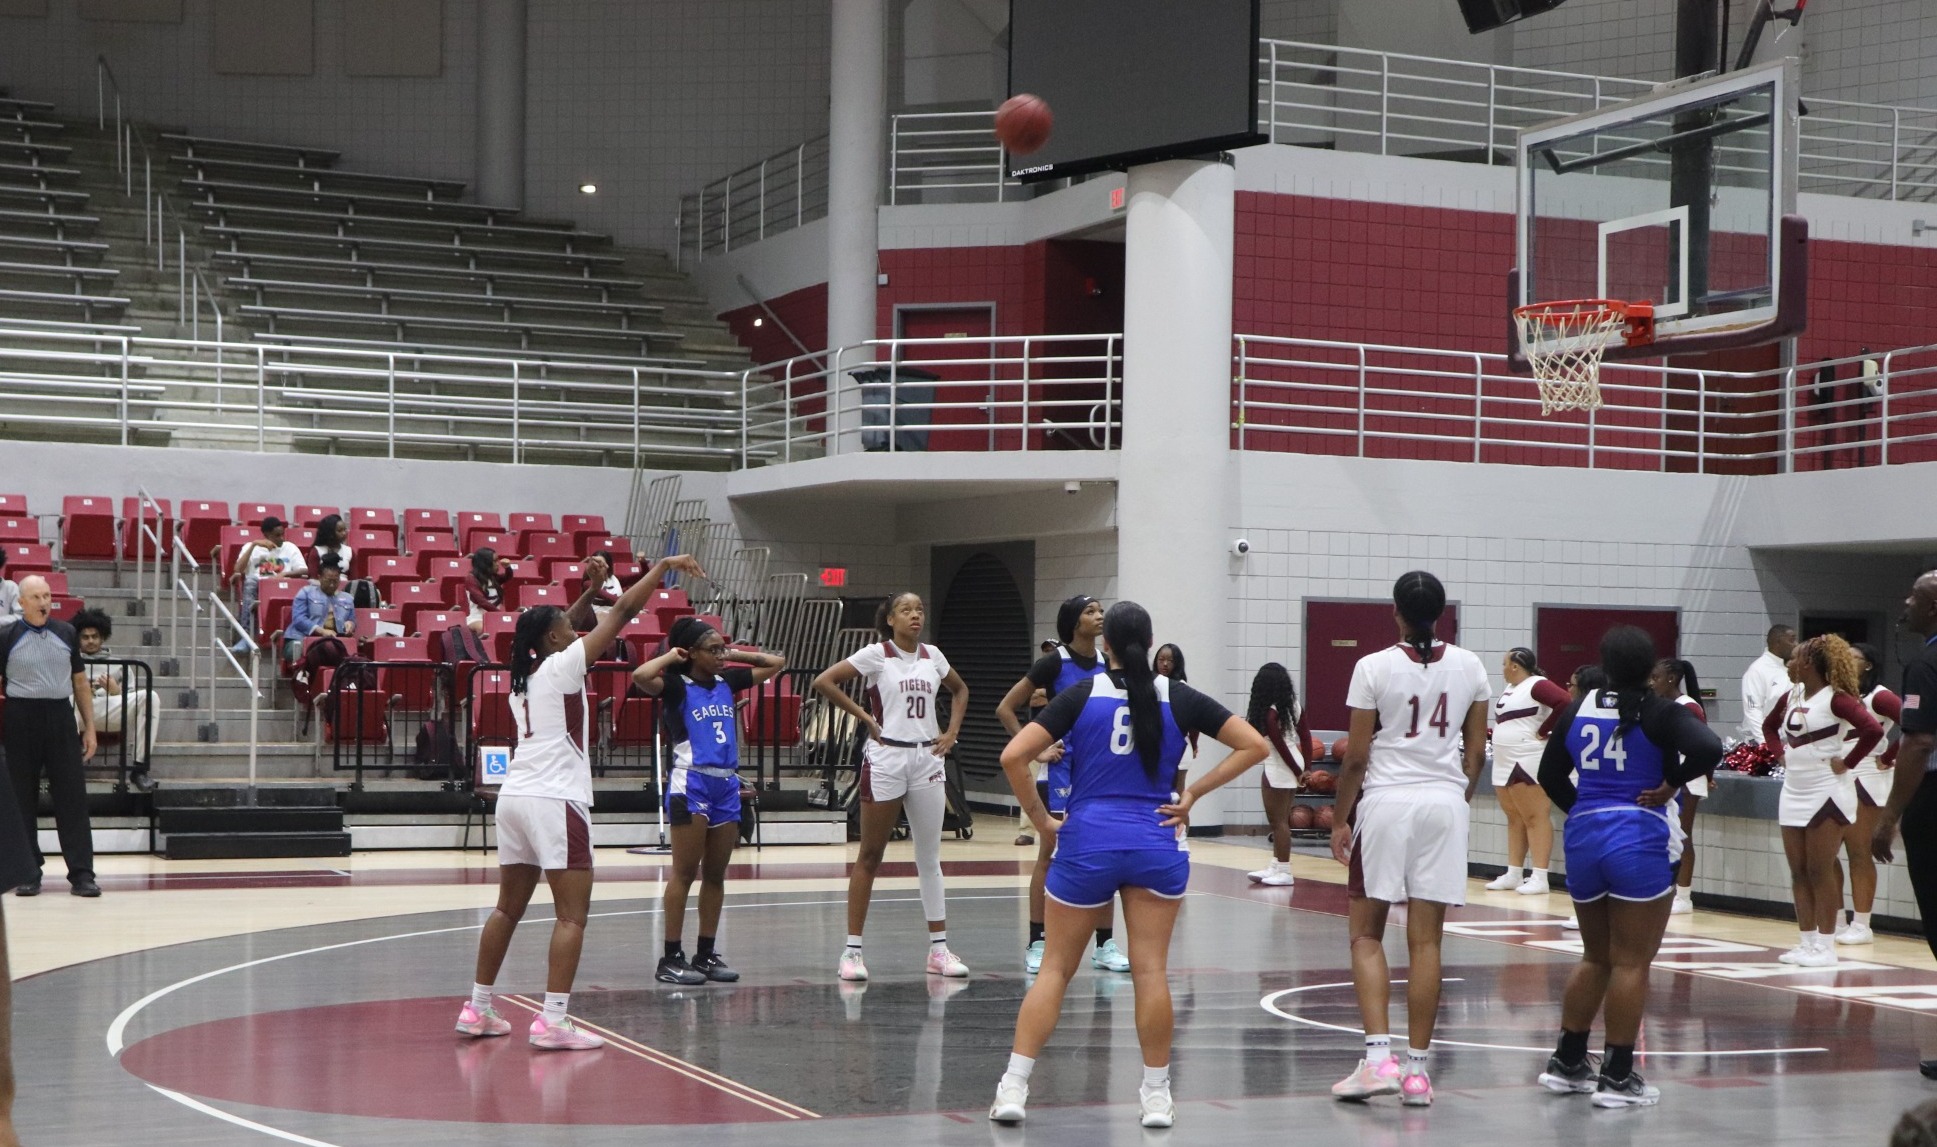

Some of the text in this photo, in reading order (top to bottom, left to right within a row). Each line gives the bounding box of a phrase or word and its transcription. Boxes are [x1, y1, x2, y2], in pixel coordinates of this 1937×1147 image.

[1011, 164, 1054, 177] DAKTRONICS
[899, 678, 932, 694] TIGERS
[522, 698, 535, 739] 1
[692, 704, 734, 721] EAGLES
[907, 695, 926, 719] 20
[1404, 692, 1449, 738] 14
[1787, 706, 1811, 731] C
[712, 721, 727, 744] 3
[1110, 706, 1135, 755] 8
[1580, 723, 1628, 772] 24
